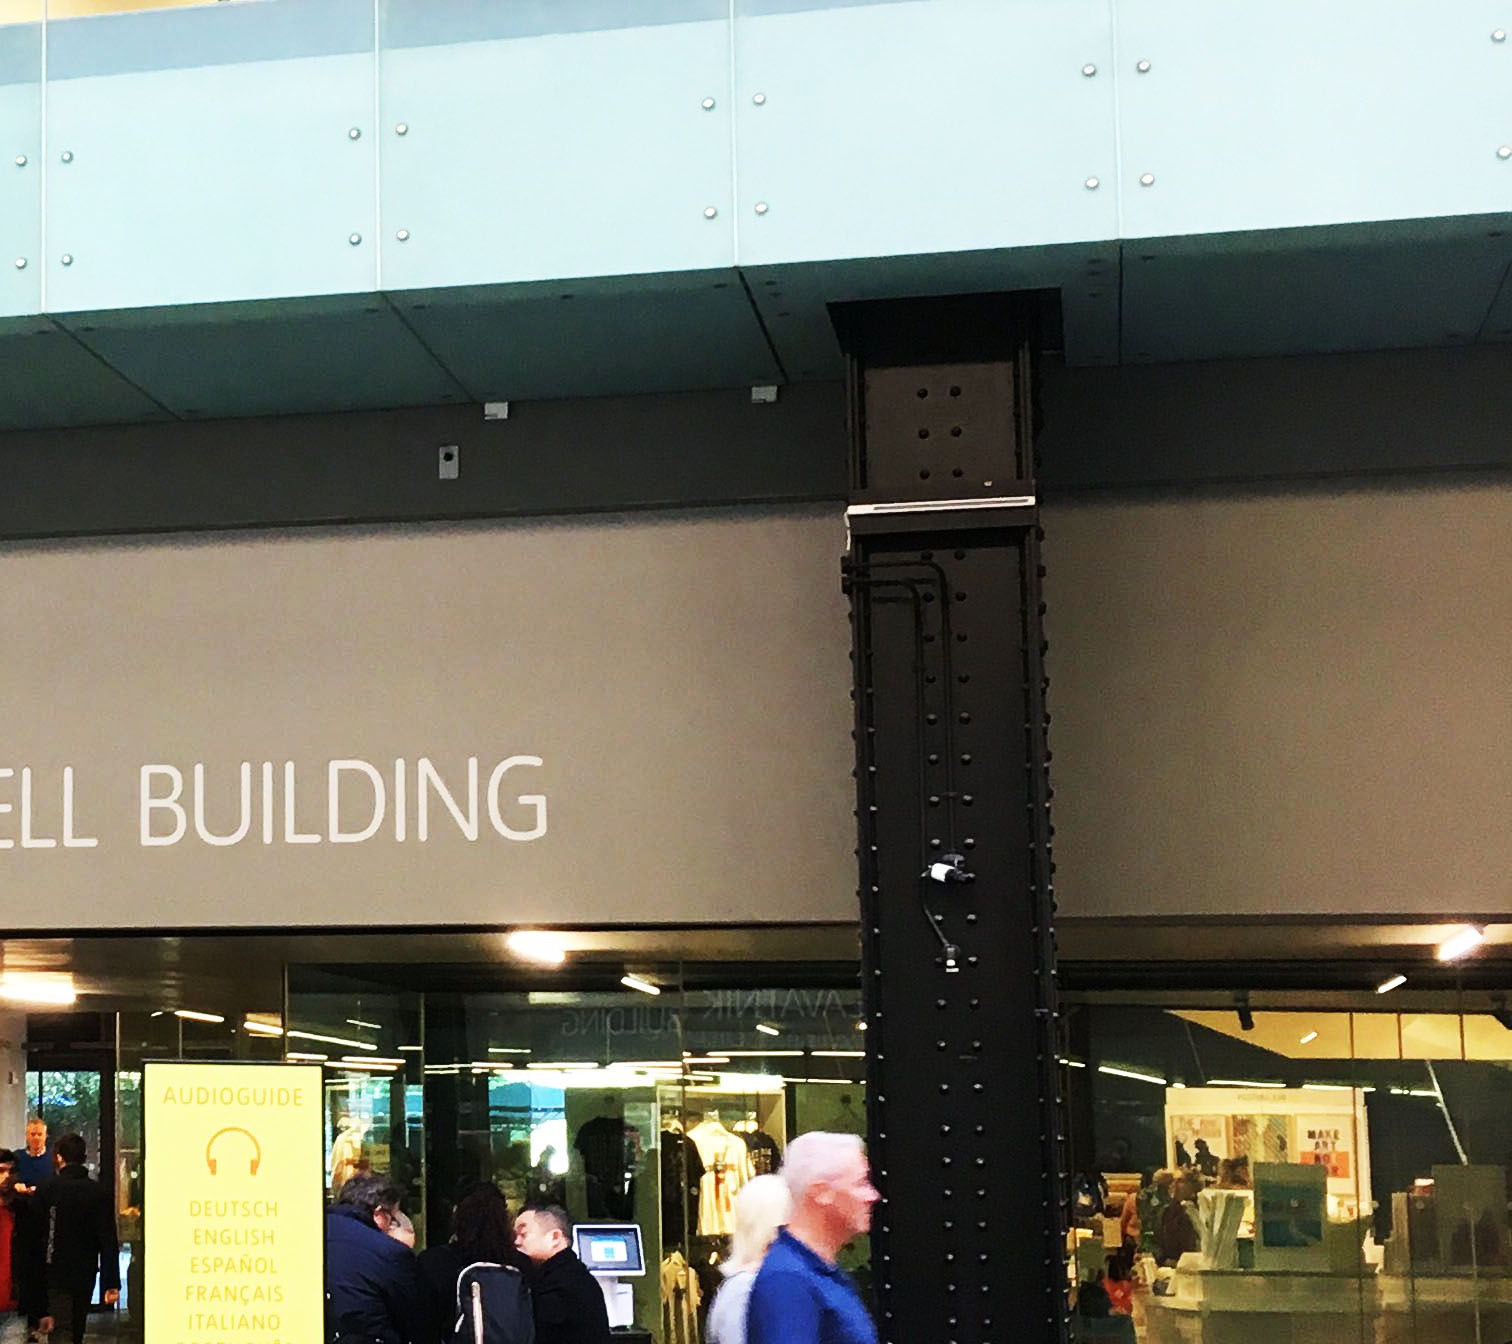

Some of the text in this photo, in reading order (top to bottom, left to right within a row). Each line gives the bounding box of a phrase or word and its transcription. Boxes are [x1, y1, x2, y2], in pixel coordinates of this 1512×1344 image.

[140, 755, 548, 847] BUILDING
[162, 1086, 304, 1107] AUDIOGUIDE
[189, 1200, 278, 1218] DEUTSCH
[193, 1228, 275, 1246] ENGLISH
[190, 1254, 277, 1274] ESPAÑOL
[185, 1284, 284, 1306] FRANÇAIS
[188, 1313, 281, 1332] ITALIANO
